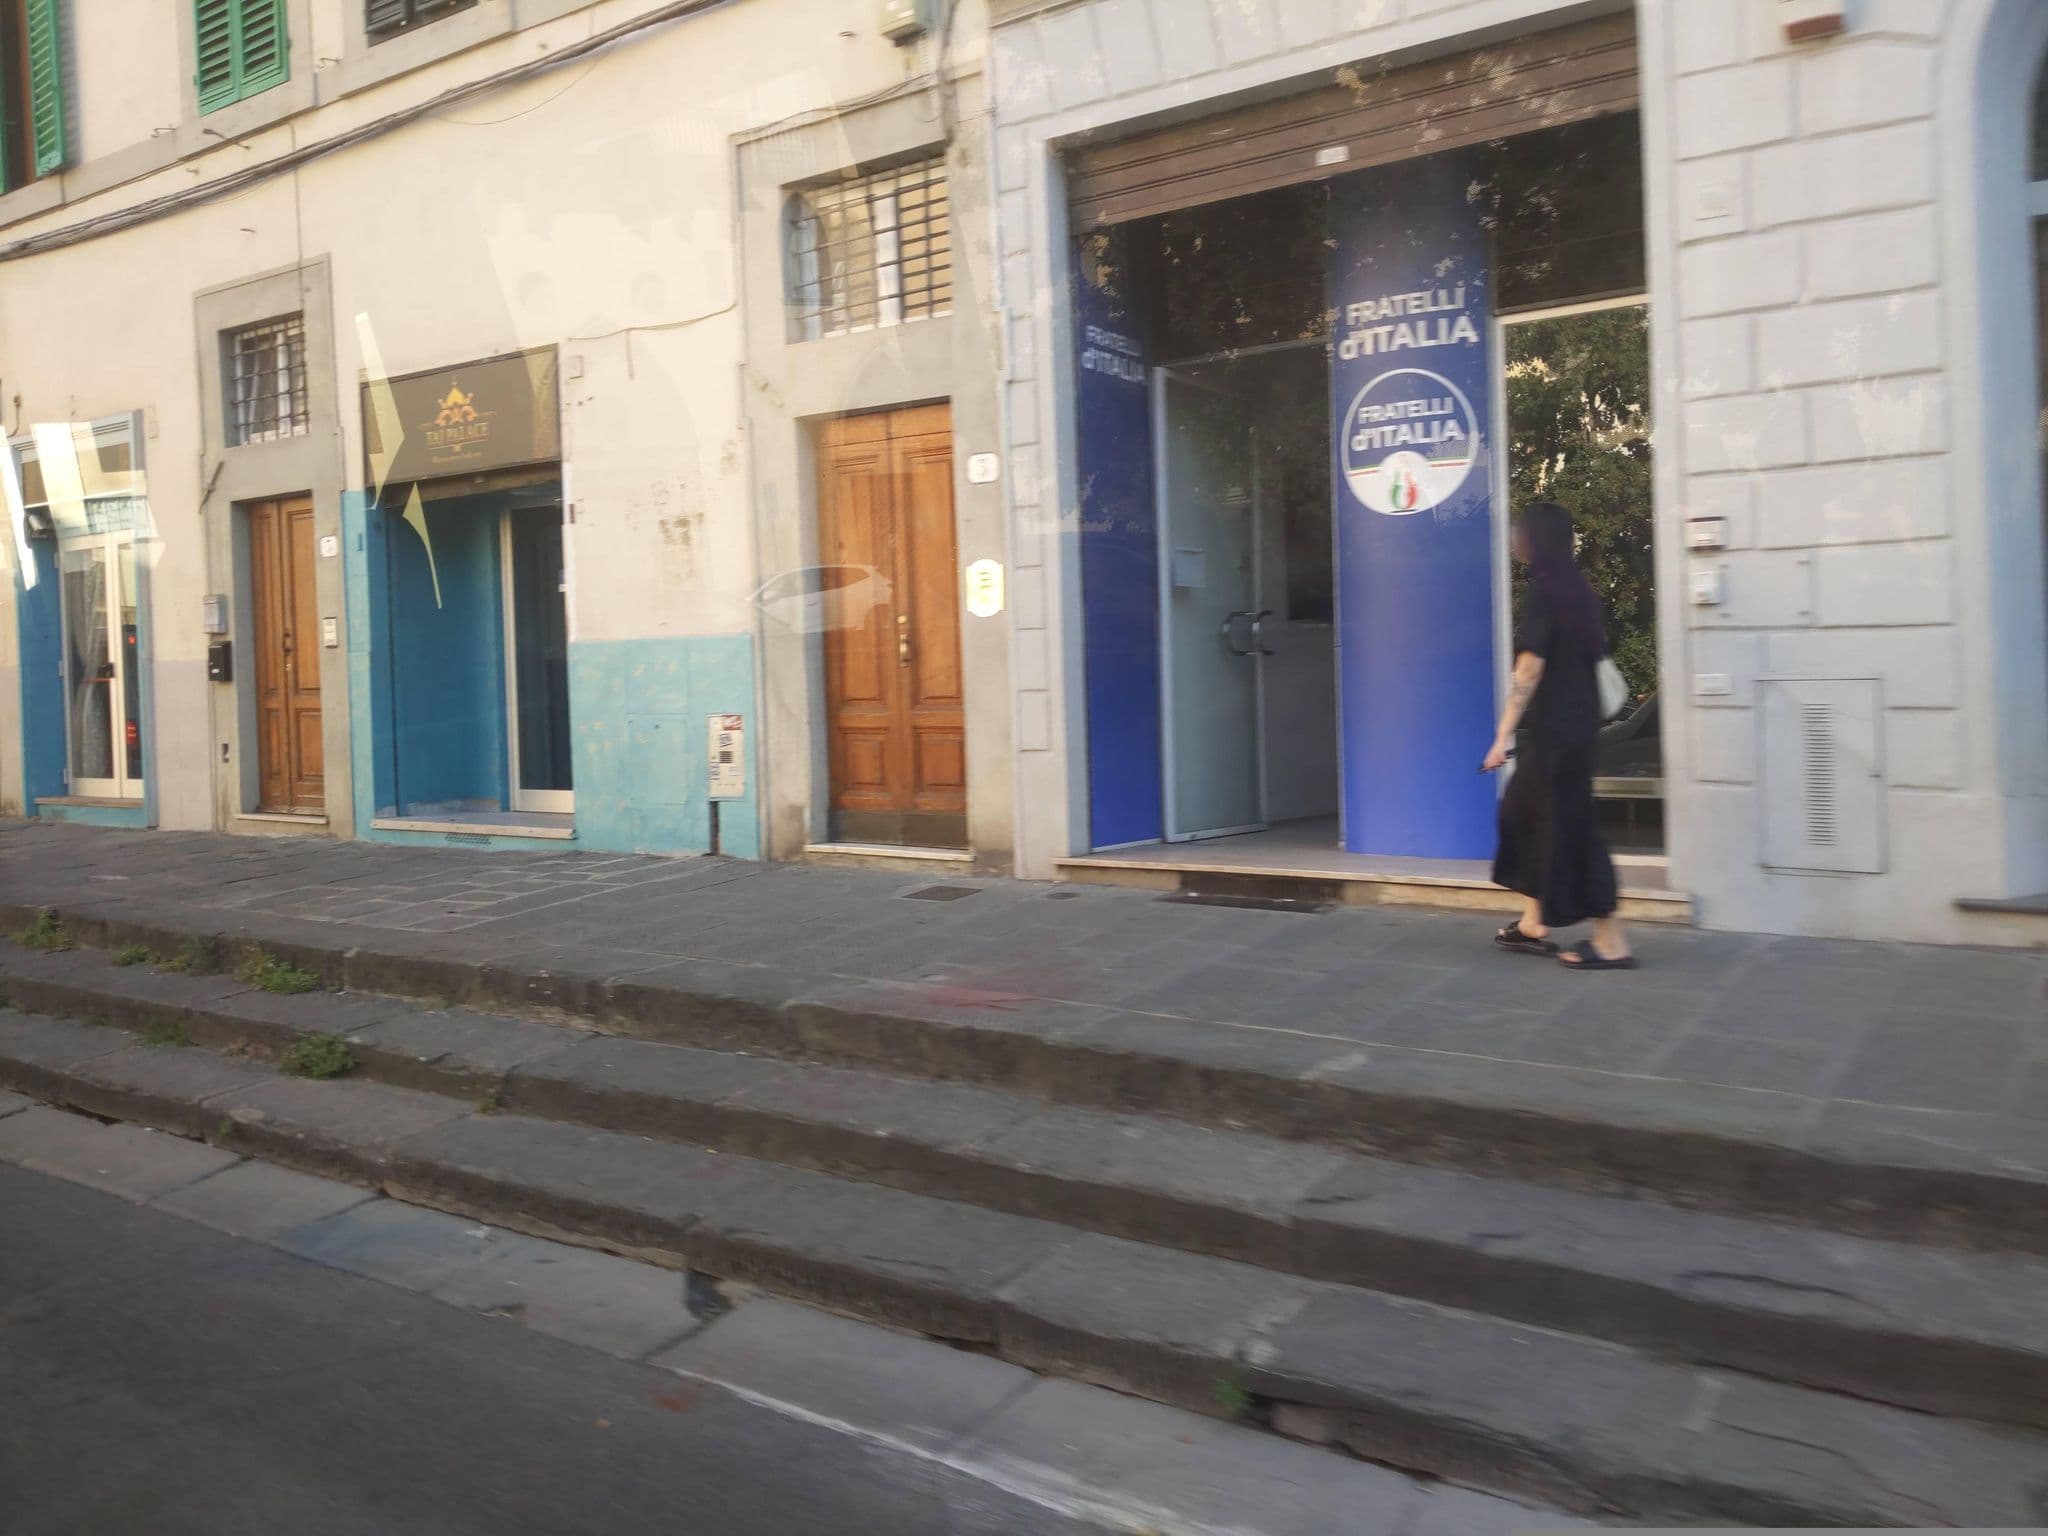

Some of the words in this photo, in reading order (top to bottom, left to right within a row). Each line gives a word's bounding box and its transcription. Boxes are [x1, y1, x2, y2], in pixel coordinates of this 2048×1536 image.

[1346, 287, 1466, 326] FRATELLI
[1338, 315, 1480, 360] d'ITALIA
[1358, 397, 1454, 424] FRATELLI
